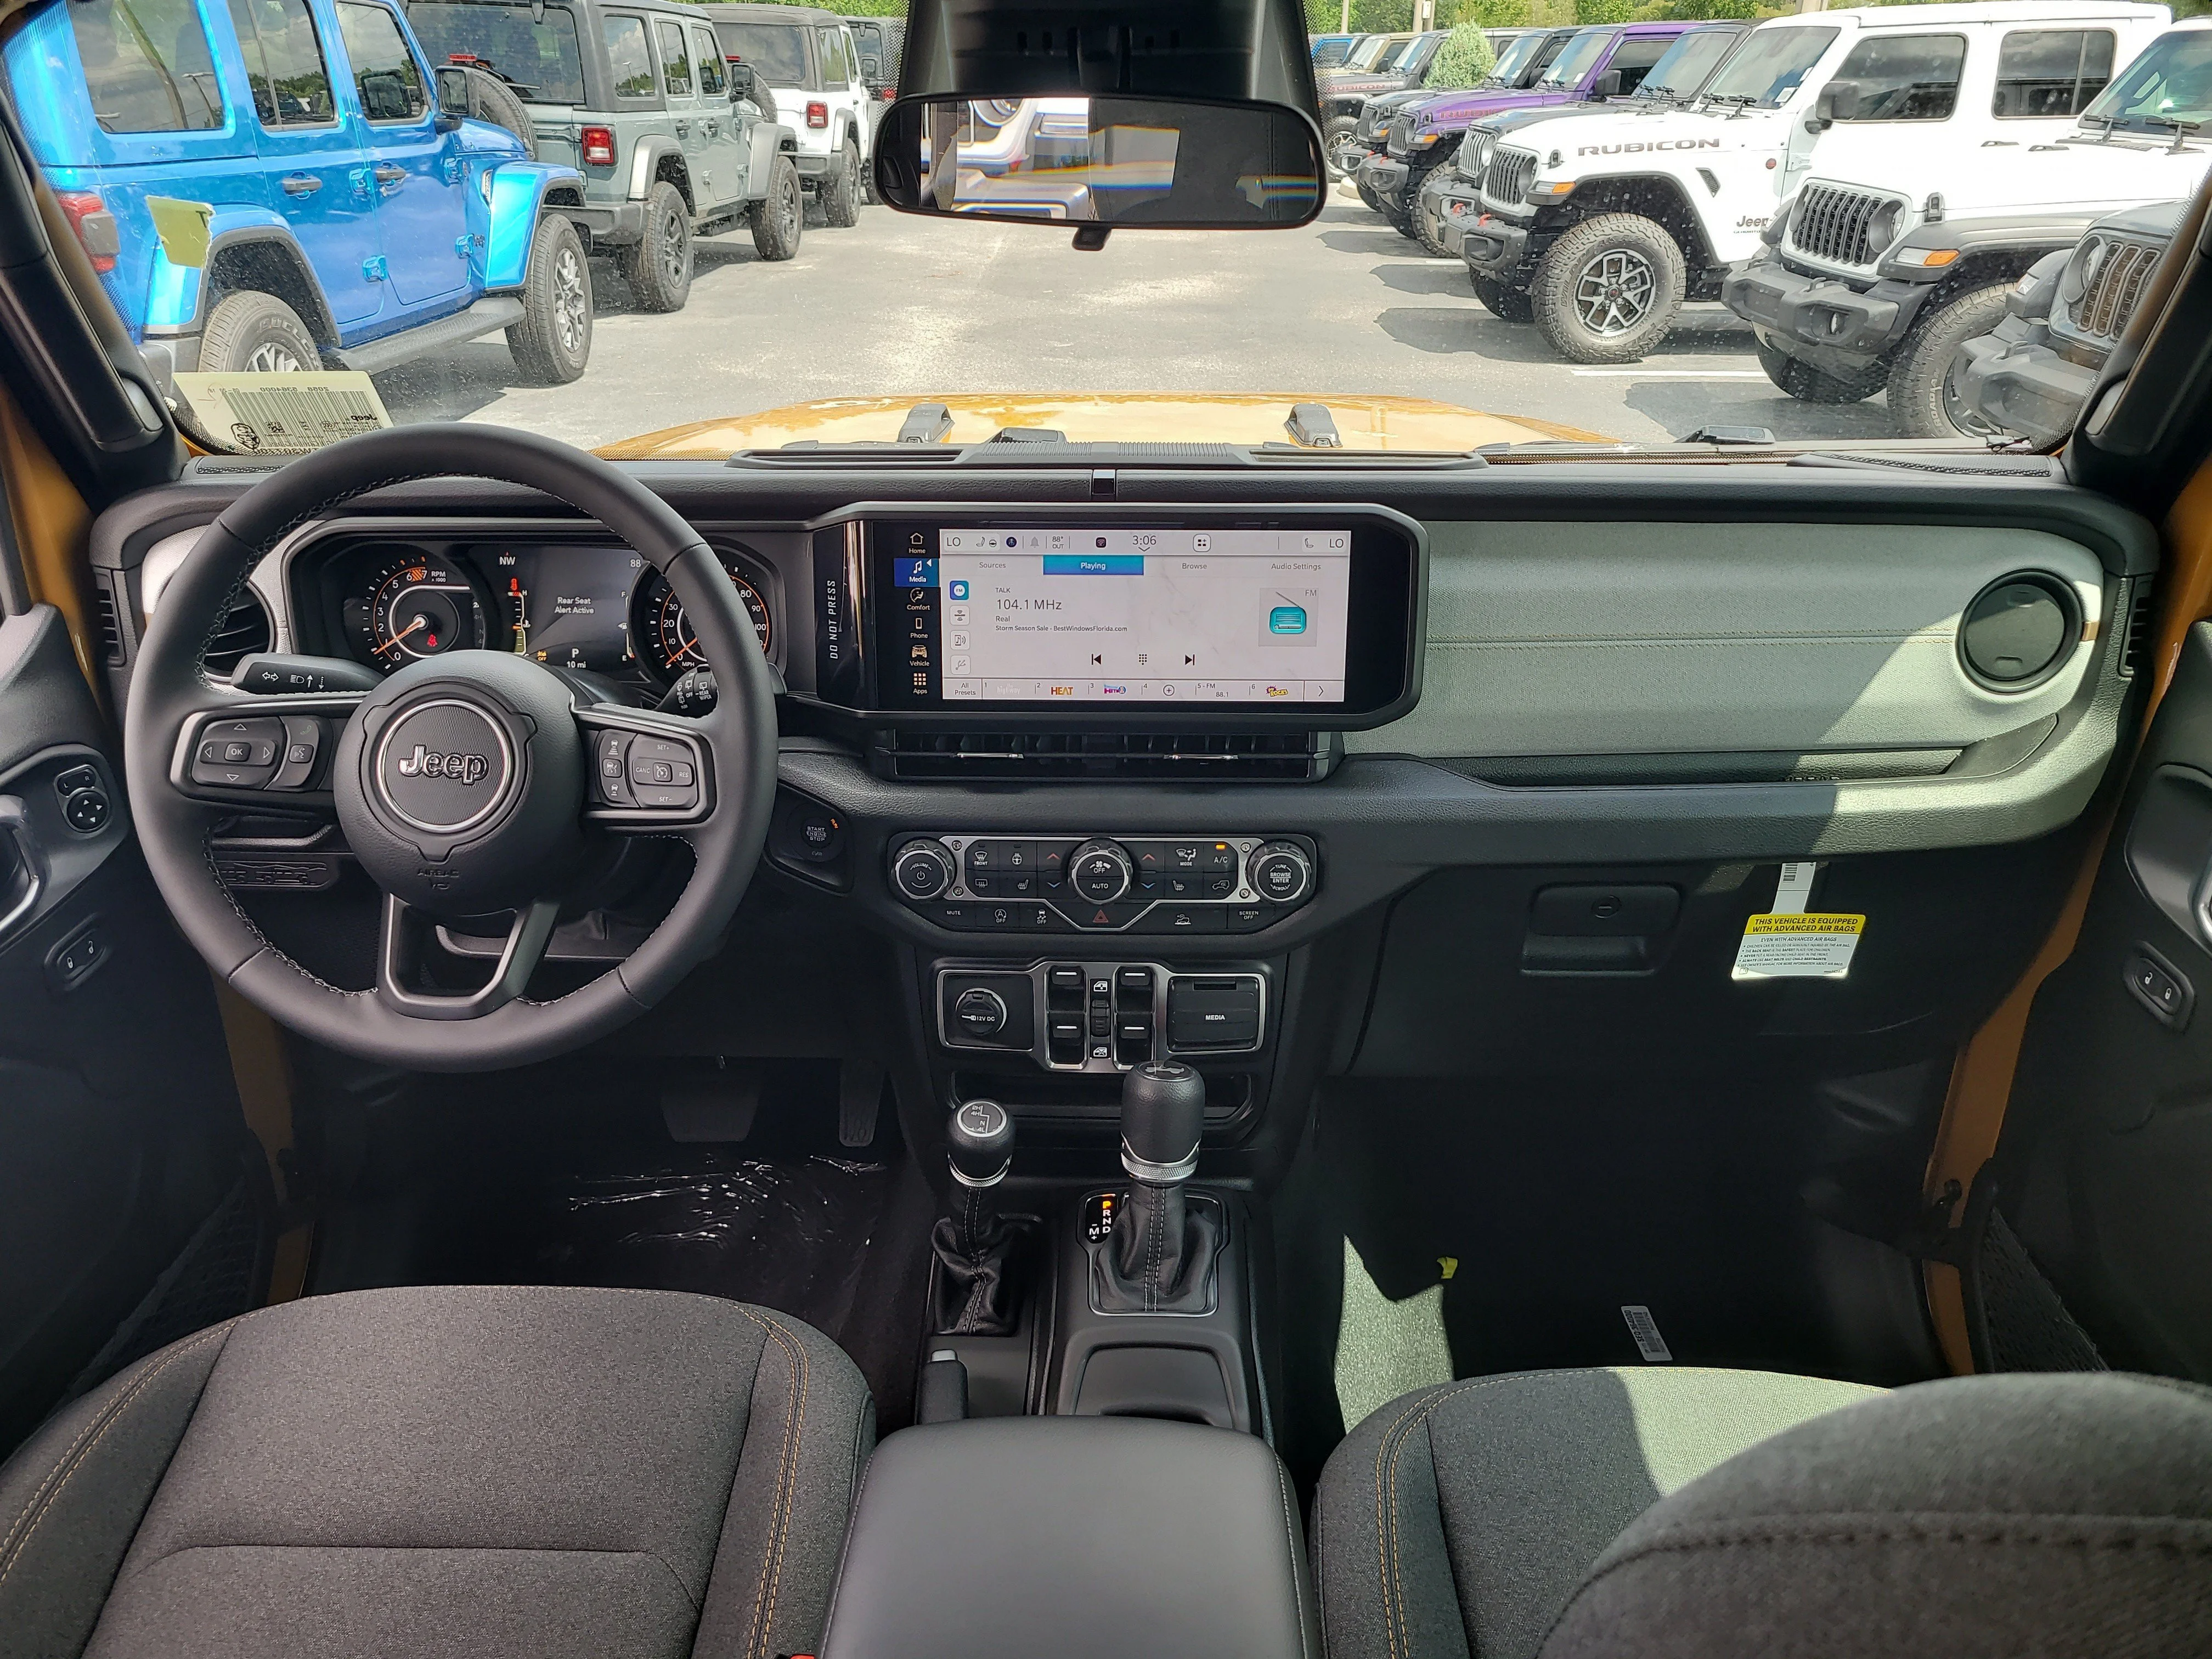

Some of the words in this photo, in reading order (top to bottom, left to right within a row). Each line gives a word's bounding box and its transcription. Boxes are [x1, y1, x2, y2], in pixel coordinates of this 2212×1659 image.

[1578, 138, 1720, 156] RUBICON
[946, 537, 961, 546] LO
[1132, 535, 1156, 545] 3:06
[1329, 538, 1344, 548] LO
[500, 556, 515, 565] NW
[630, 559, 641, 568] 88
[407, 573, 412, 581] 6
[422, 570, 427, 579] 7
[393, 580, 399, 589] 5
[382, 592, 388, 601] 4
[827, 580, 837, 615] PRESS
[997, 599, 1029, 610] 104.1
[1034, 599, 1062, 610] MHz
[377, 607, 384, 616] 3
[378, 623, 385, 631] 2
[828, 619, 837, 640] NOT
[394, 652, 401, 661] 0
[572, 648, 579, 658] P
[830, 645, 838, 659] DO
[1051, 686, 1074, 695] HEAT
[399, 744, 489, 785] Jeep
[1102, 1200, 1111, 1209] P
[1089, 1227, 1099, 1235] M
